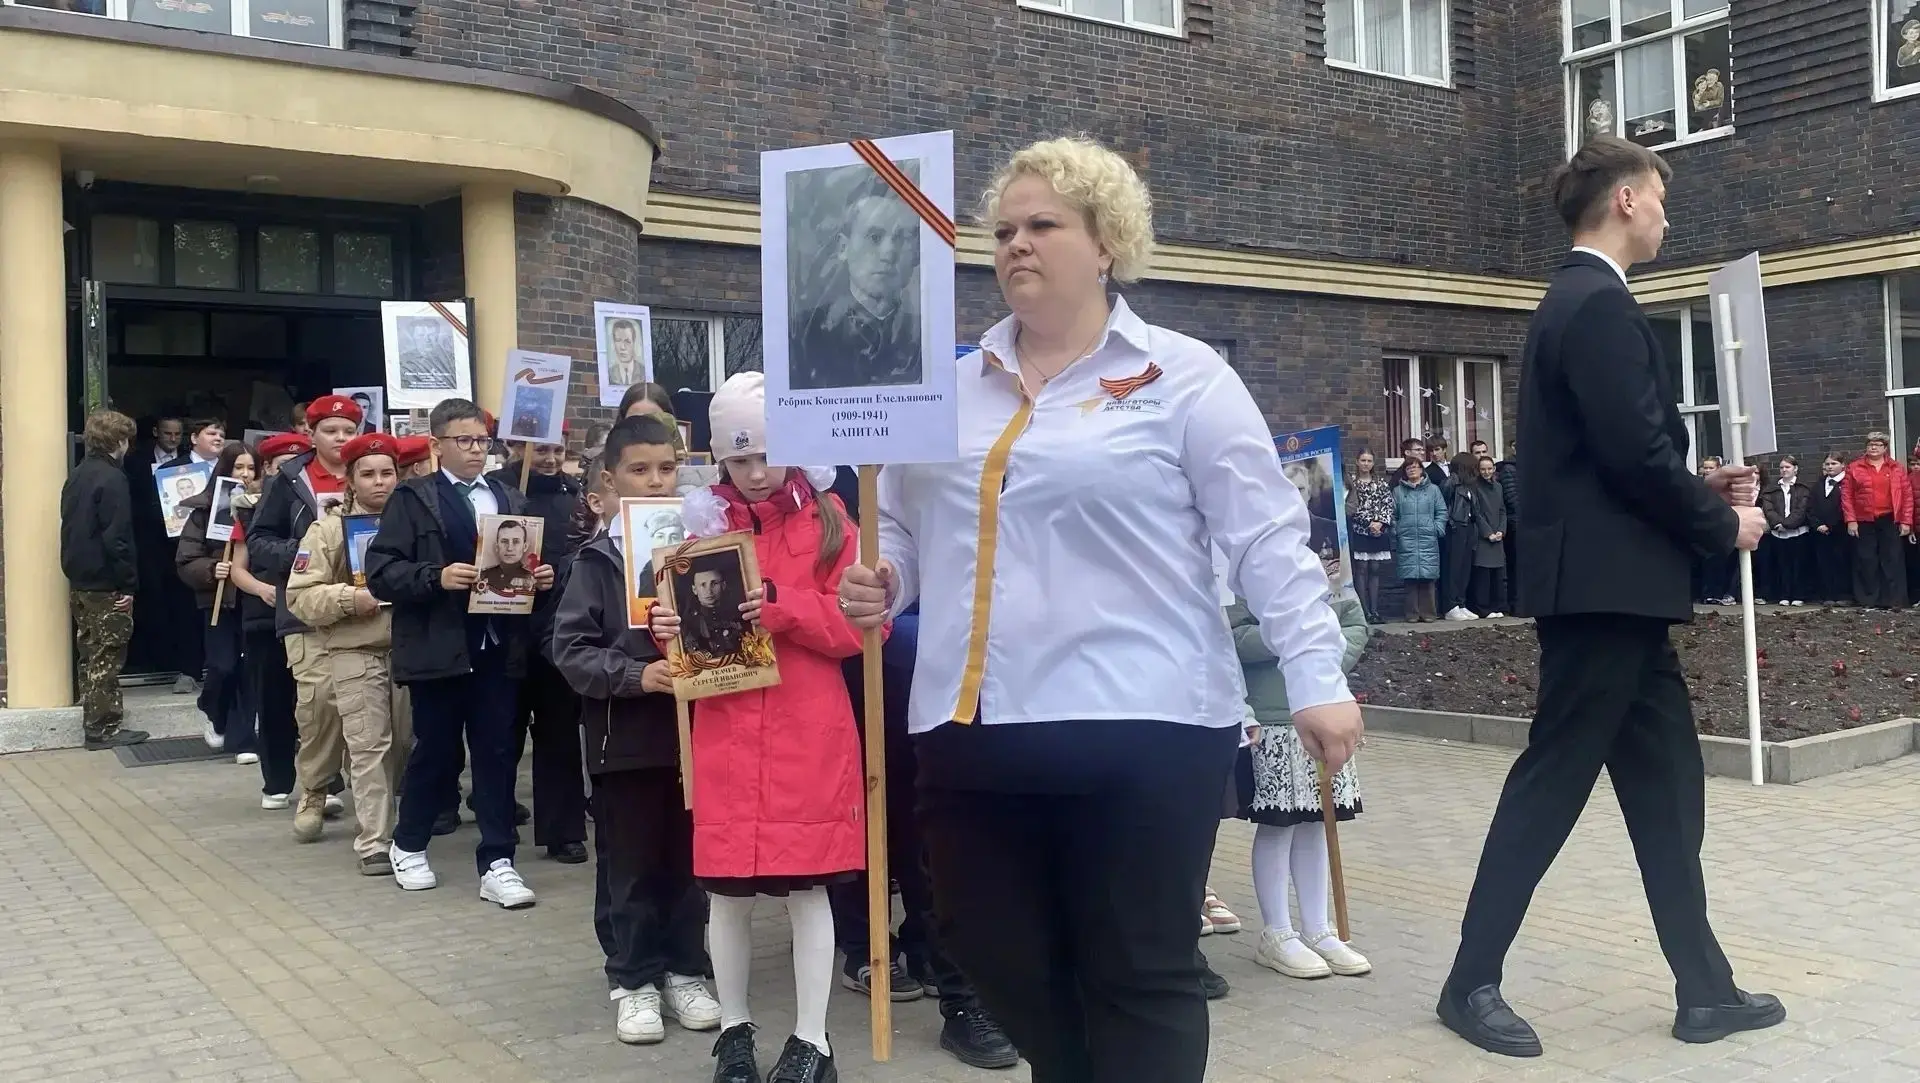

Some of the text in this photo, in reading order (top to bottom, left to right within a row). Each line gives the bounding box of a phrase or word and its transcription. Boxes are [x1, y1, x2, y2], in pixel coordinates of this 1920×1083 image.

[778, 393, 943, 408] Ребрик Константин Емельянович
[831, 410, 888, 423] (1909-1941)
[831, 426, 889, 438] КАПИТАН
[692, 677, 719, 686] СЕРГЕЙ
[719, 671, 758, 681] ИВАНОВИЧ
